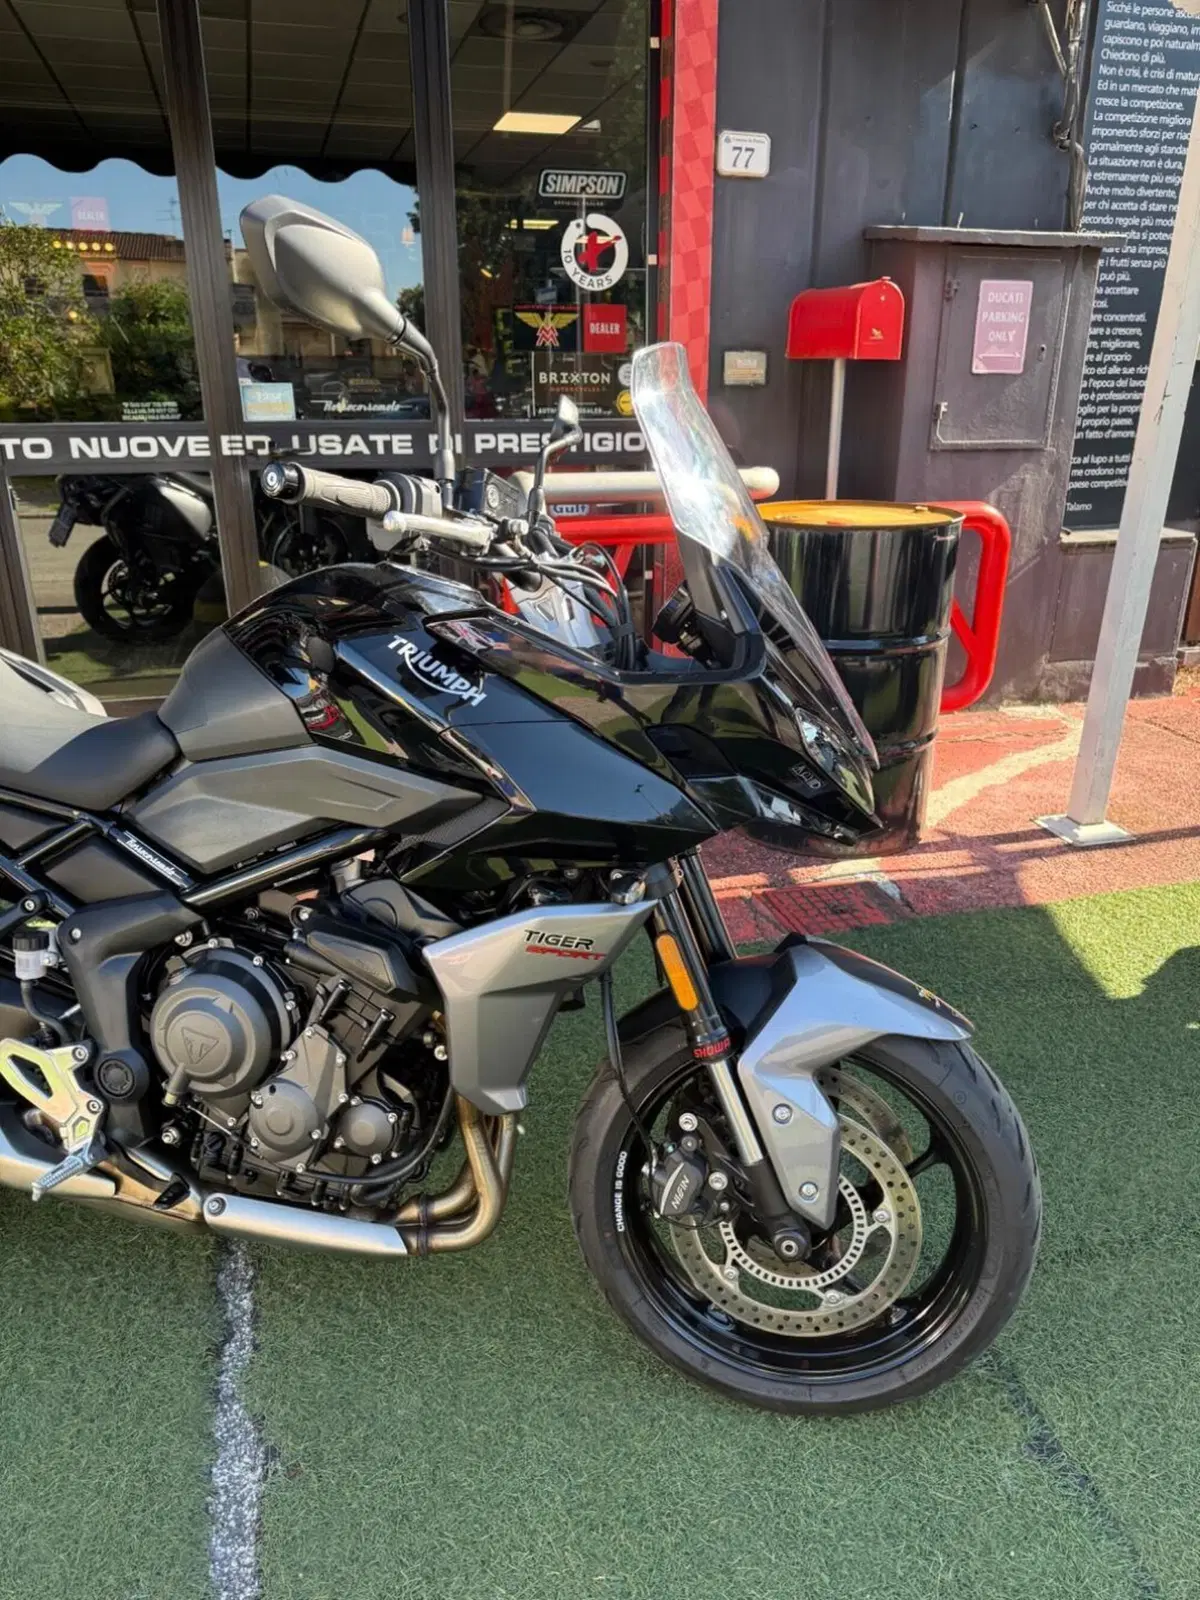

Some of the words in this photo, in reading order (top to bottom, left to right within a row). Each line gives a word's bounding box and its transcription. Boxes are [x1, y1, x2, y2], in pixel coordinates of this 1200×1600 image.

[1106, 1, 1132, 12] Sicché
[1133, 3, 1140, 14] le
[1141, 5, 1174, 17] persone
[1104, 18, 1146, 32] guardano,
[1148, 20, 1189, 36] viaggiano,
[1102, 32, 1142, 47] capiscono
[1143, 39, 1149, 47] e
[1150, 37, 1164, 49] poi
[1101, 48, 1140, 61] Chiedono
[1142, 51, 1150, 62] di
[1099, 64, 1116, 75] Non
[1118, 65, 1123, 76] è
[1143, 67, 1149, 78] è
[1150, 68, 1165, 79] crisi
[1166, 68, 1175, 79] di
[1097, 80, 1108, 90] Ed
[1110, 80, 1117, 91] in
[1119, 84, 1130, 92] un
[1131, 84, 1164, 94] mercato
[1165, 84, 1180, 95] che
[1095, 97, 1119, 107] cresce
[1121, 96, 1128, 107] la
[1129, 99, 1184, 111] competizione.
[1094, 110, 1103, 121] La
[1104, 112, 1158, 124] competizione
[1159, 113, 1191, 127] migliora
[1092, 125, 1138, 138] imponendo
[1139, 127, 1160, 139] sforzi
[1161, 130, 1175, 141] per
[1089, 140, 1144, 153] giornalmente
[1144, 143, 1160, 156] agli
[732, 146, 755, 169] 77
[1088, 155, 1097, 166] La
[1099, 155, 1139, 167] situazione
[1140, 159, 1156, 168] non
[1157, 158, 1163, 168] è
[1164, 158, 1183, 170] dura,
[545, 174, 620, 194] SIMPSON
[1093, 171, 1150, 182] estremamente
[1150, 172, 1164, 184] più
[1086, 184, 1110, 195] Anche
[1111, 185, 1135, 196] molto
[1136, 186, 1177, 199] divertente,
[1083, 200, 1097, 211] per
[1098, 199, 1110, 210] chi
[1111, 202, 1138, 211] accetta
[1140, 200, 1148, 211] di
[1148, 203, 1168, 212] stare
[1081, 213, 1113, 225] secondo
[1115, 215, 1140, 228] regole
[1140, 216, 1154, 228] più
[1141, 229, 1148, 240] si
[1138, 244, 1168, 255] impresa,
[563, 249, 573, 264] 10
[571, 267, 613, 288] YEARS
[1110, 257, 1129, 267] frutti
[1130, 259, 1152, 268] senza
[1153, 259, 1166, 270] più
[1100, 271, 1115, 282] può
[1105, 286, 1139, 295] accettare
[988, 291, 1024, 304] DUCATI
[982, 311, 1025, 323] PARKING
[1103, 312, 1147, 322] concentrati.
[589, 322, 621, 334] DEALER
[1112, 327, 1142, 336] crescere,
[988, 330, 1016, 341] ONLY
[1101, 338, 1140, 351] migliorare,
[1095, 352, 1103, 362] al
[1103, 352, 1132, 363] proprio
[1097, 365, 1107, 374] ed
[1108, 365, 1121, 374] alle
[539, 371, 611, 384] BRIXTON
[1116, 377, 1128, 387] del
[1097, 405, 1109, 416] per
[1111, 403, 1118, 413] la
[1082, 417, 1110, 428] proprio
[1085, 429, 1103, 439] fatto
[69, 436, 211, 459] NUOVE
[220, 435, 271, 456] ED
[292, 434, 413, 455] USATE
[475, 431, 646, 453] PREIGIO
[1082, 454, 1090, 464] al
[1091, 454, 1107, 466] lupo
[1115, 453, 1131, 463] tutti
[1084, 467, 1114, 477] credono
[1115, 465, 1127, 475] nel
[1068, 481, 1089, 491] paese
[552, 504, 588, 514] Gulf
[1066, 502, 1092, 511] Talamo
[387, 635, 487, 706] TRIUMPH
[524, 929, 594, 950] TIGER
[525, 944, 607, 961] SPORT
[615, 1151, 628, 1178] GOOD
[614, 1179, 623, 1190] IS
[614, 1192, 625, 1232] CHANGE
